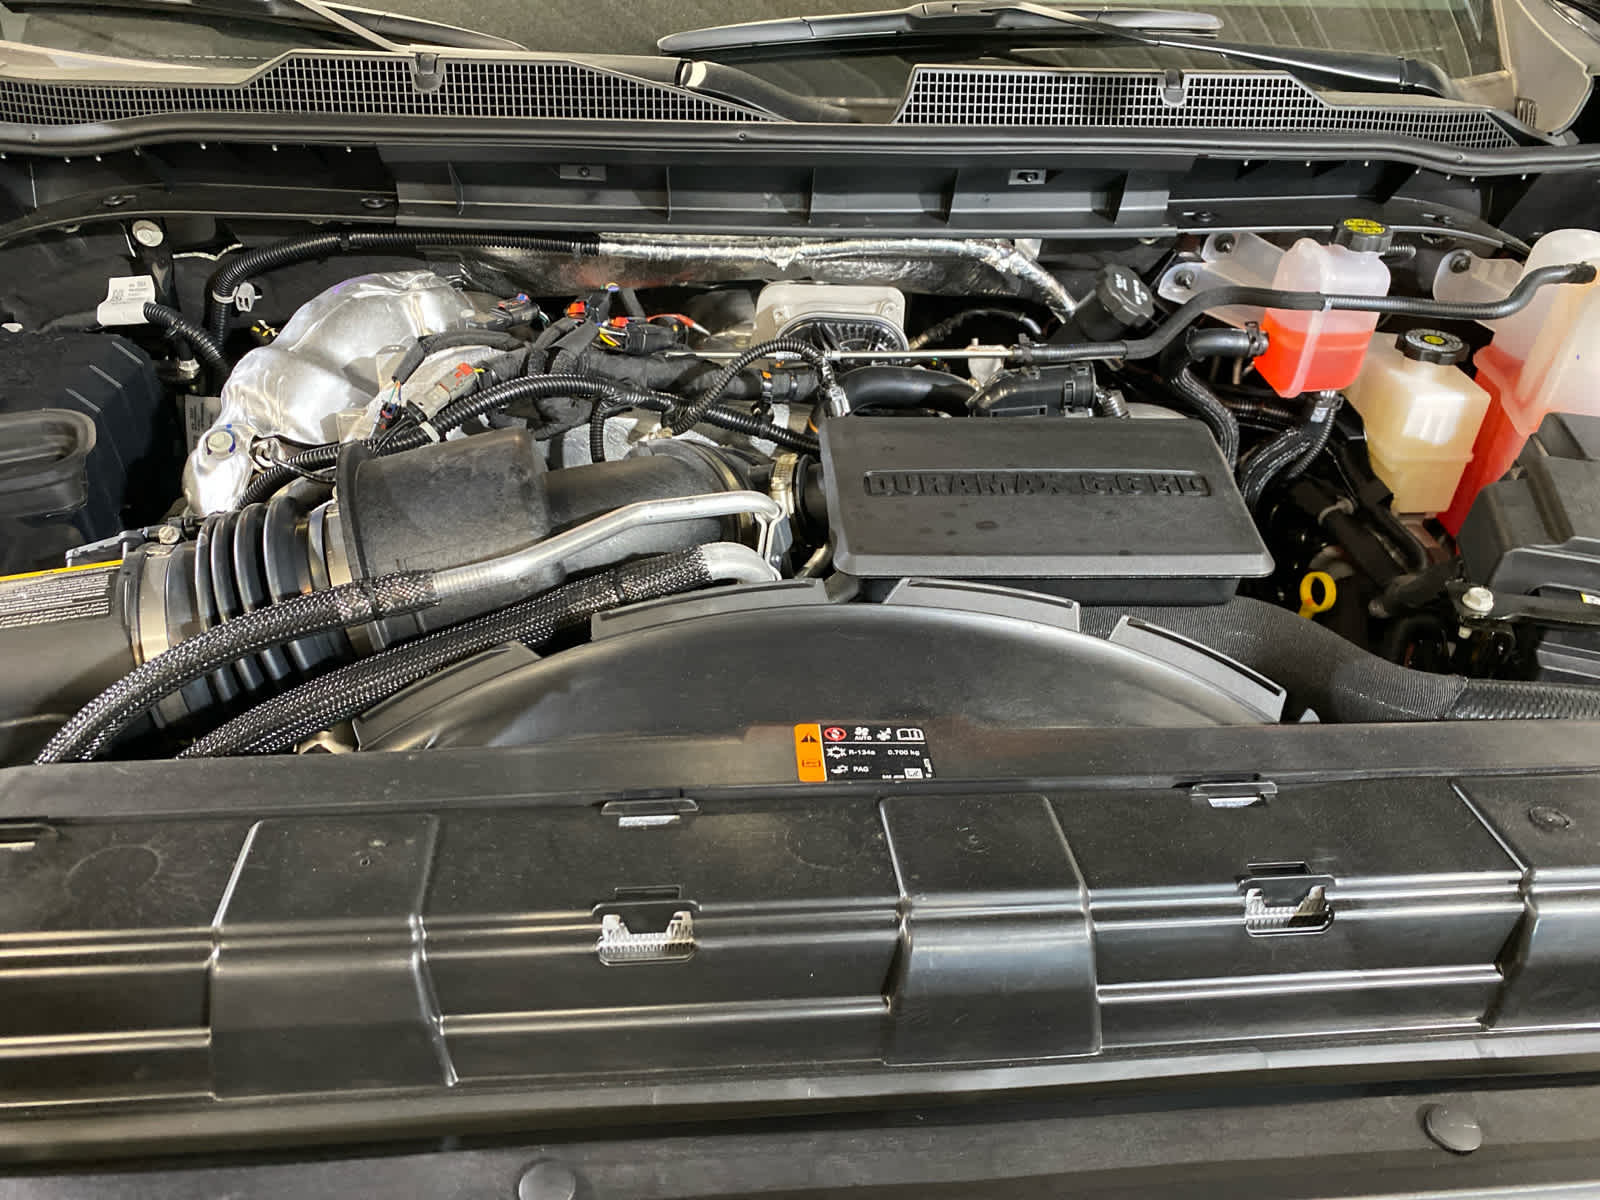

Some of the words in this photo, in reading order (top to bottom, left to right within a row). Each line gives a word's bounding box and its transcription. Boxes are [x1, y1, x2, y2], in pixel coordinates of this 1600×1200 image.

[864, 473, 1061, 497] DURAMAX
[910, 749, 920, 757] kg
[853, 765, 870, 773] PAG
